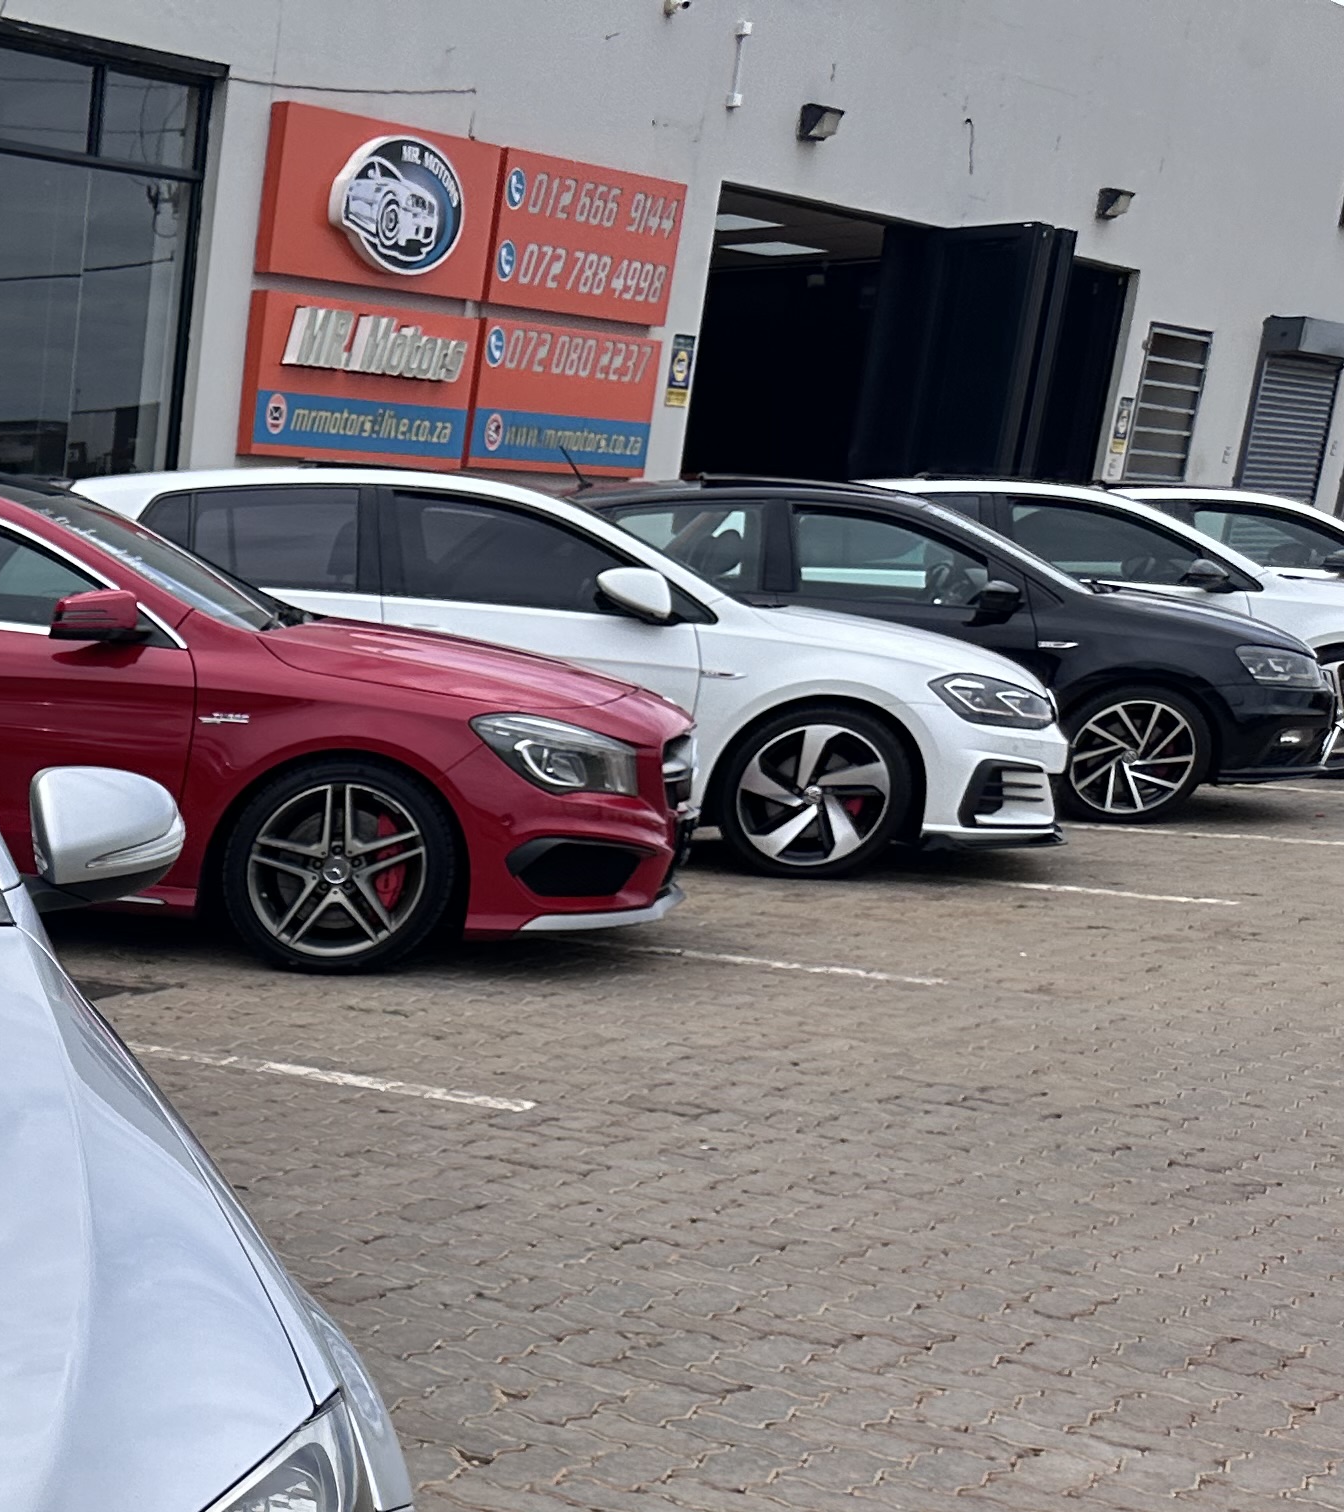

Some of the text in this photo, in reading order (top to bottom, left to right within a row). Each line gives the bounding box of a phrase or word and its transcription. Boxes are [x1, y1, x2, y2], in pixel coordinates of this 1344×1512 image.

[423, 151, 459, 208] MOTORS
[528, 172, 680, 239] 012 666 9144
[518, 243, 668, 303] 072 788 4998
[349, 313, 468, 384] Motors
[505, 329, 653, 384] 072 080 2237
[290, 407, 453, 444] mrmotorslive.co.za
